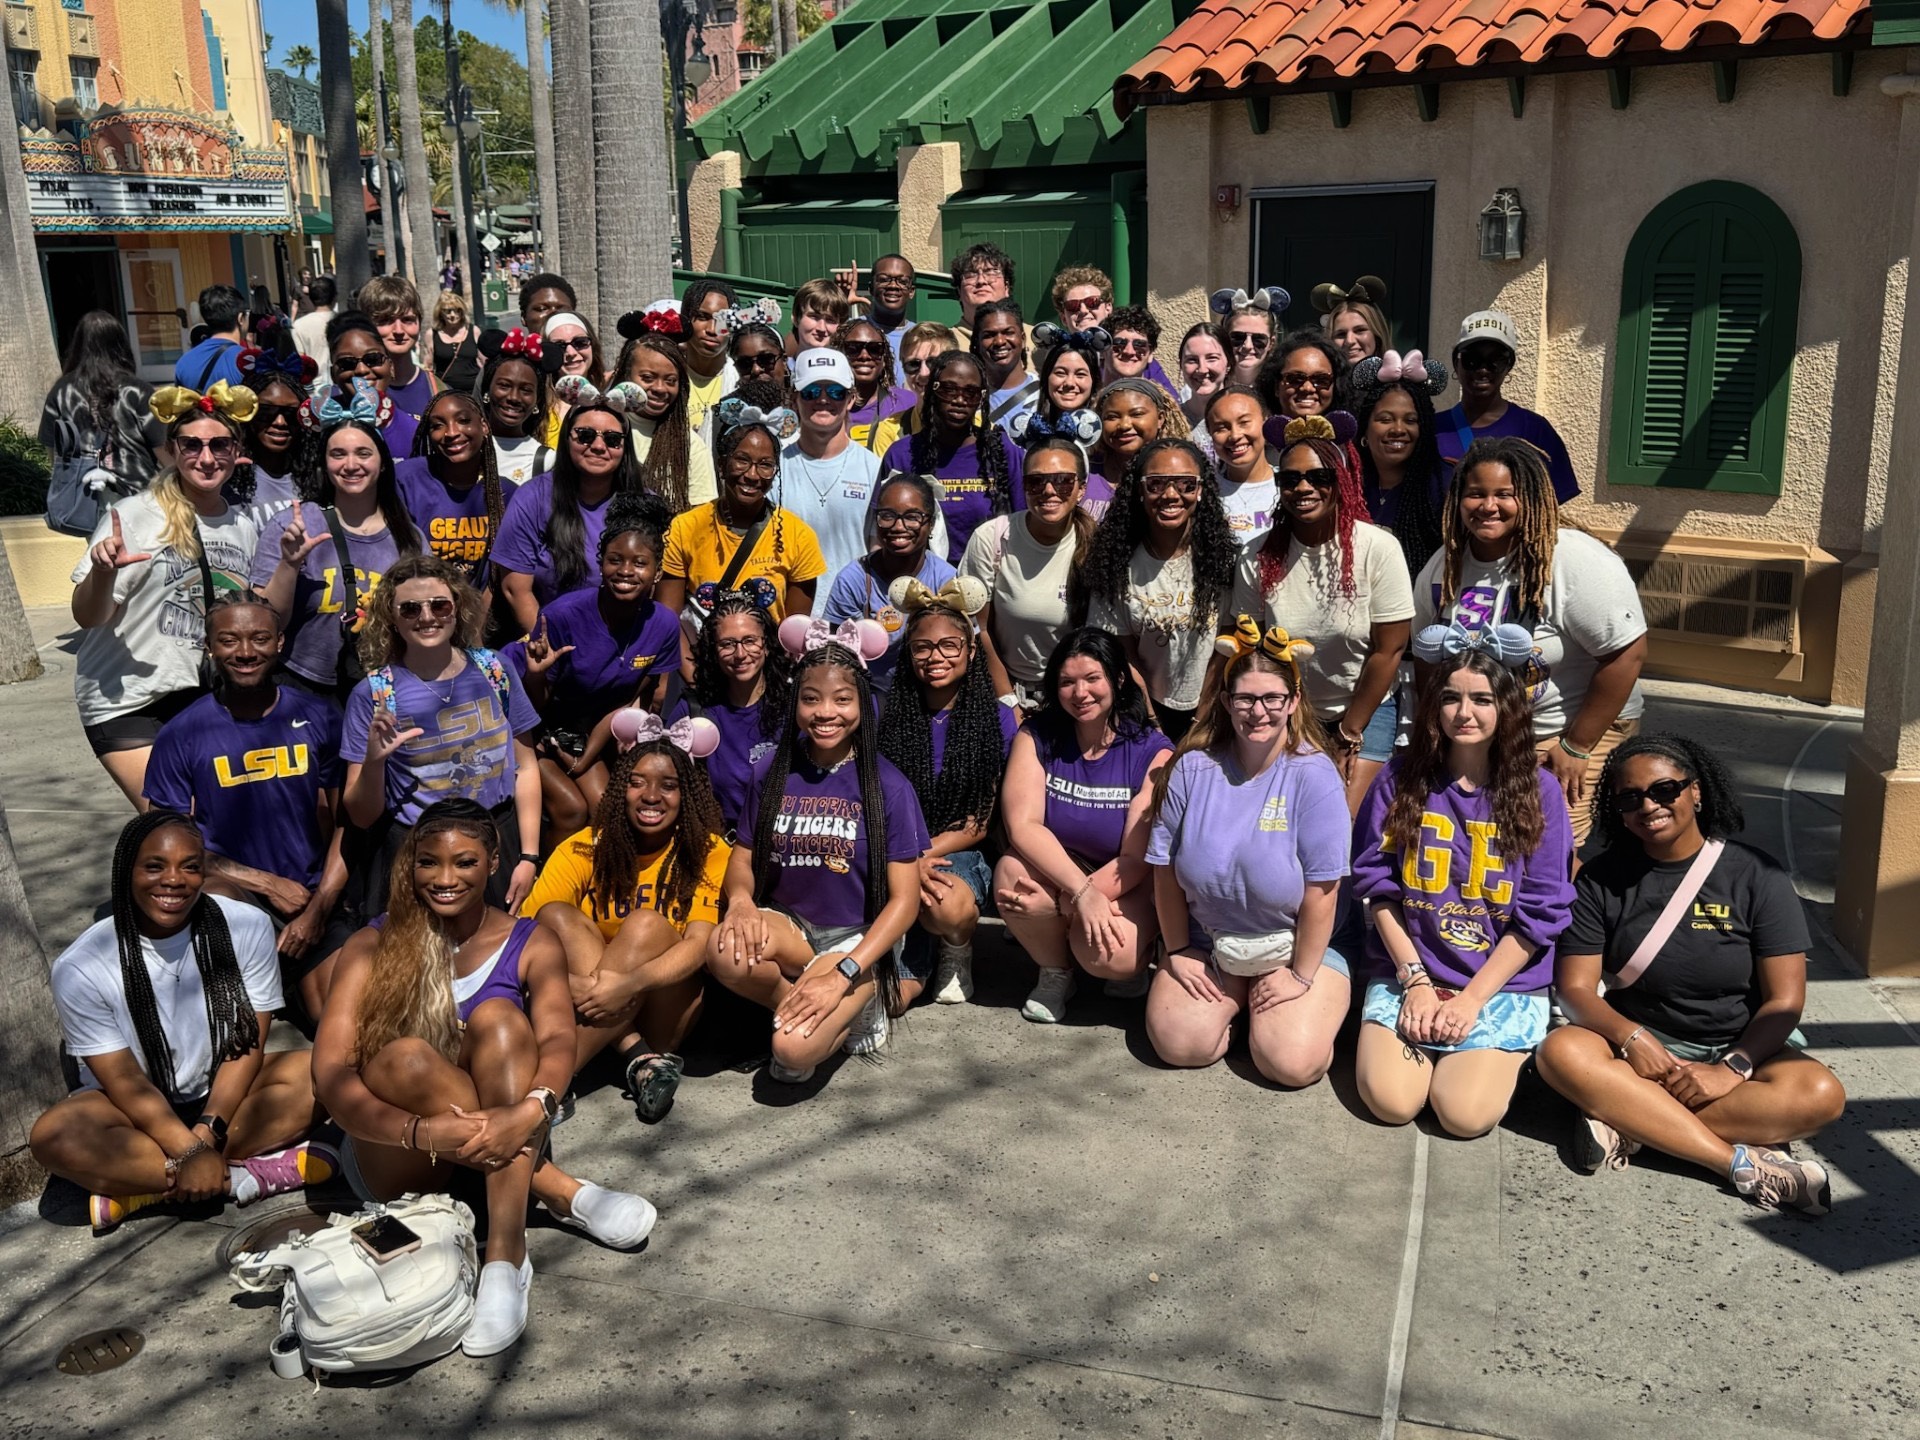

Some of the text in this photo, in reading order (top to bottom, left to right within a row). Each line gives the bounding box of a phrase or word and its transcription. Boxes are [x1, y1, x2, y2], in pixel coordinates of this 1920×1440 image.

[103, 141, 225, 172] SUNSET
[1468, 319, 1507, 336] TIGERS
[808, 357, 836, 368] LSU
[843, 489, 866, 500] LSU
[430, 537, 487, 562] TIGER
[213, 743, 308, 788] LSU
[1046, 773, 1128, 798] LSU Museum of Art
[798, 796, 861, 821] TIGERS
[794, 816, 857, 841] TIGERS
[790, 835, 855, 859] TIGERS
[788, 855, 821, 867] 1860
[1439, 902, 1487, 917] State
[1694, 903, 1730, 918] LSU
